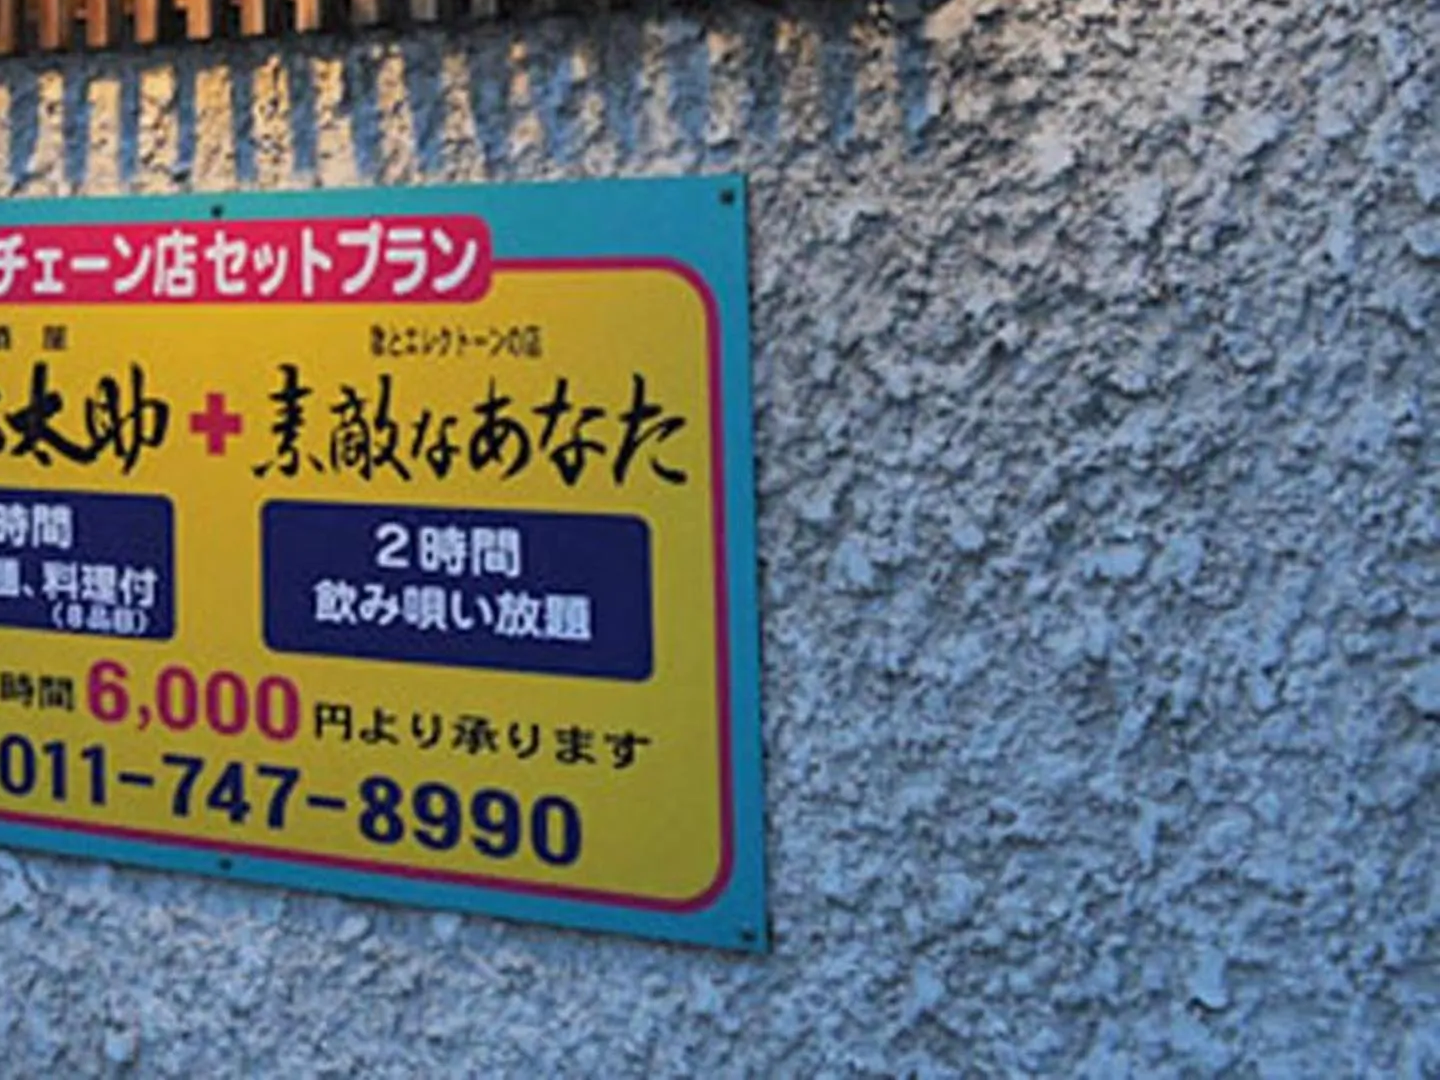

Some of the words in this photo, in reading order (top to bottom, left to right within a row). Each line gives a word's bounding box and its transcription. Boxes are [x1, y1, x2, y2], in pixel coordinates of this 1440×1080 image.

[252, 364, 688, 487] 素敵なあなた
[375, 522, 521, 579] 2時間
[313, 578, 593, 642] 飲み唄い放題
